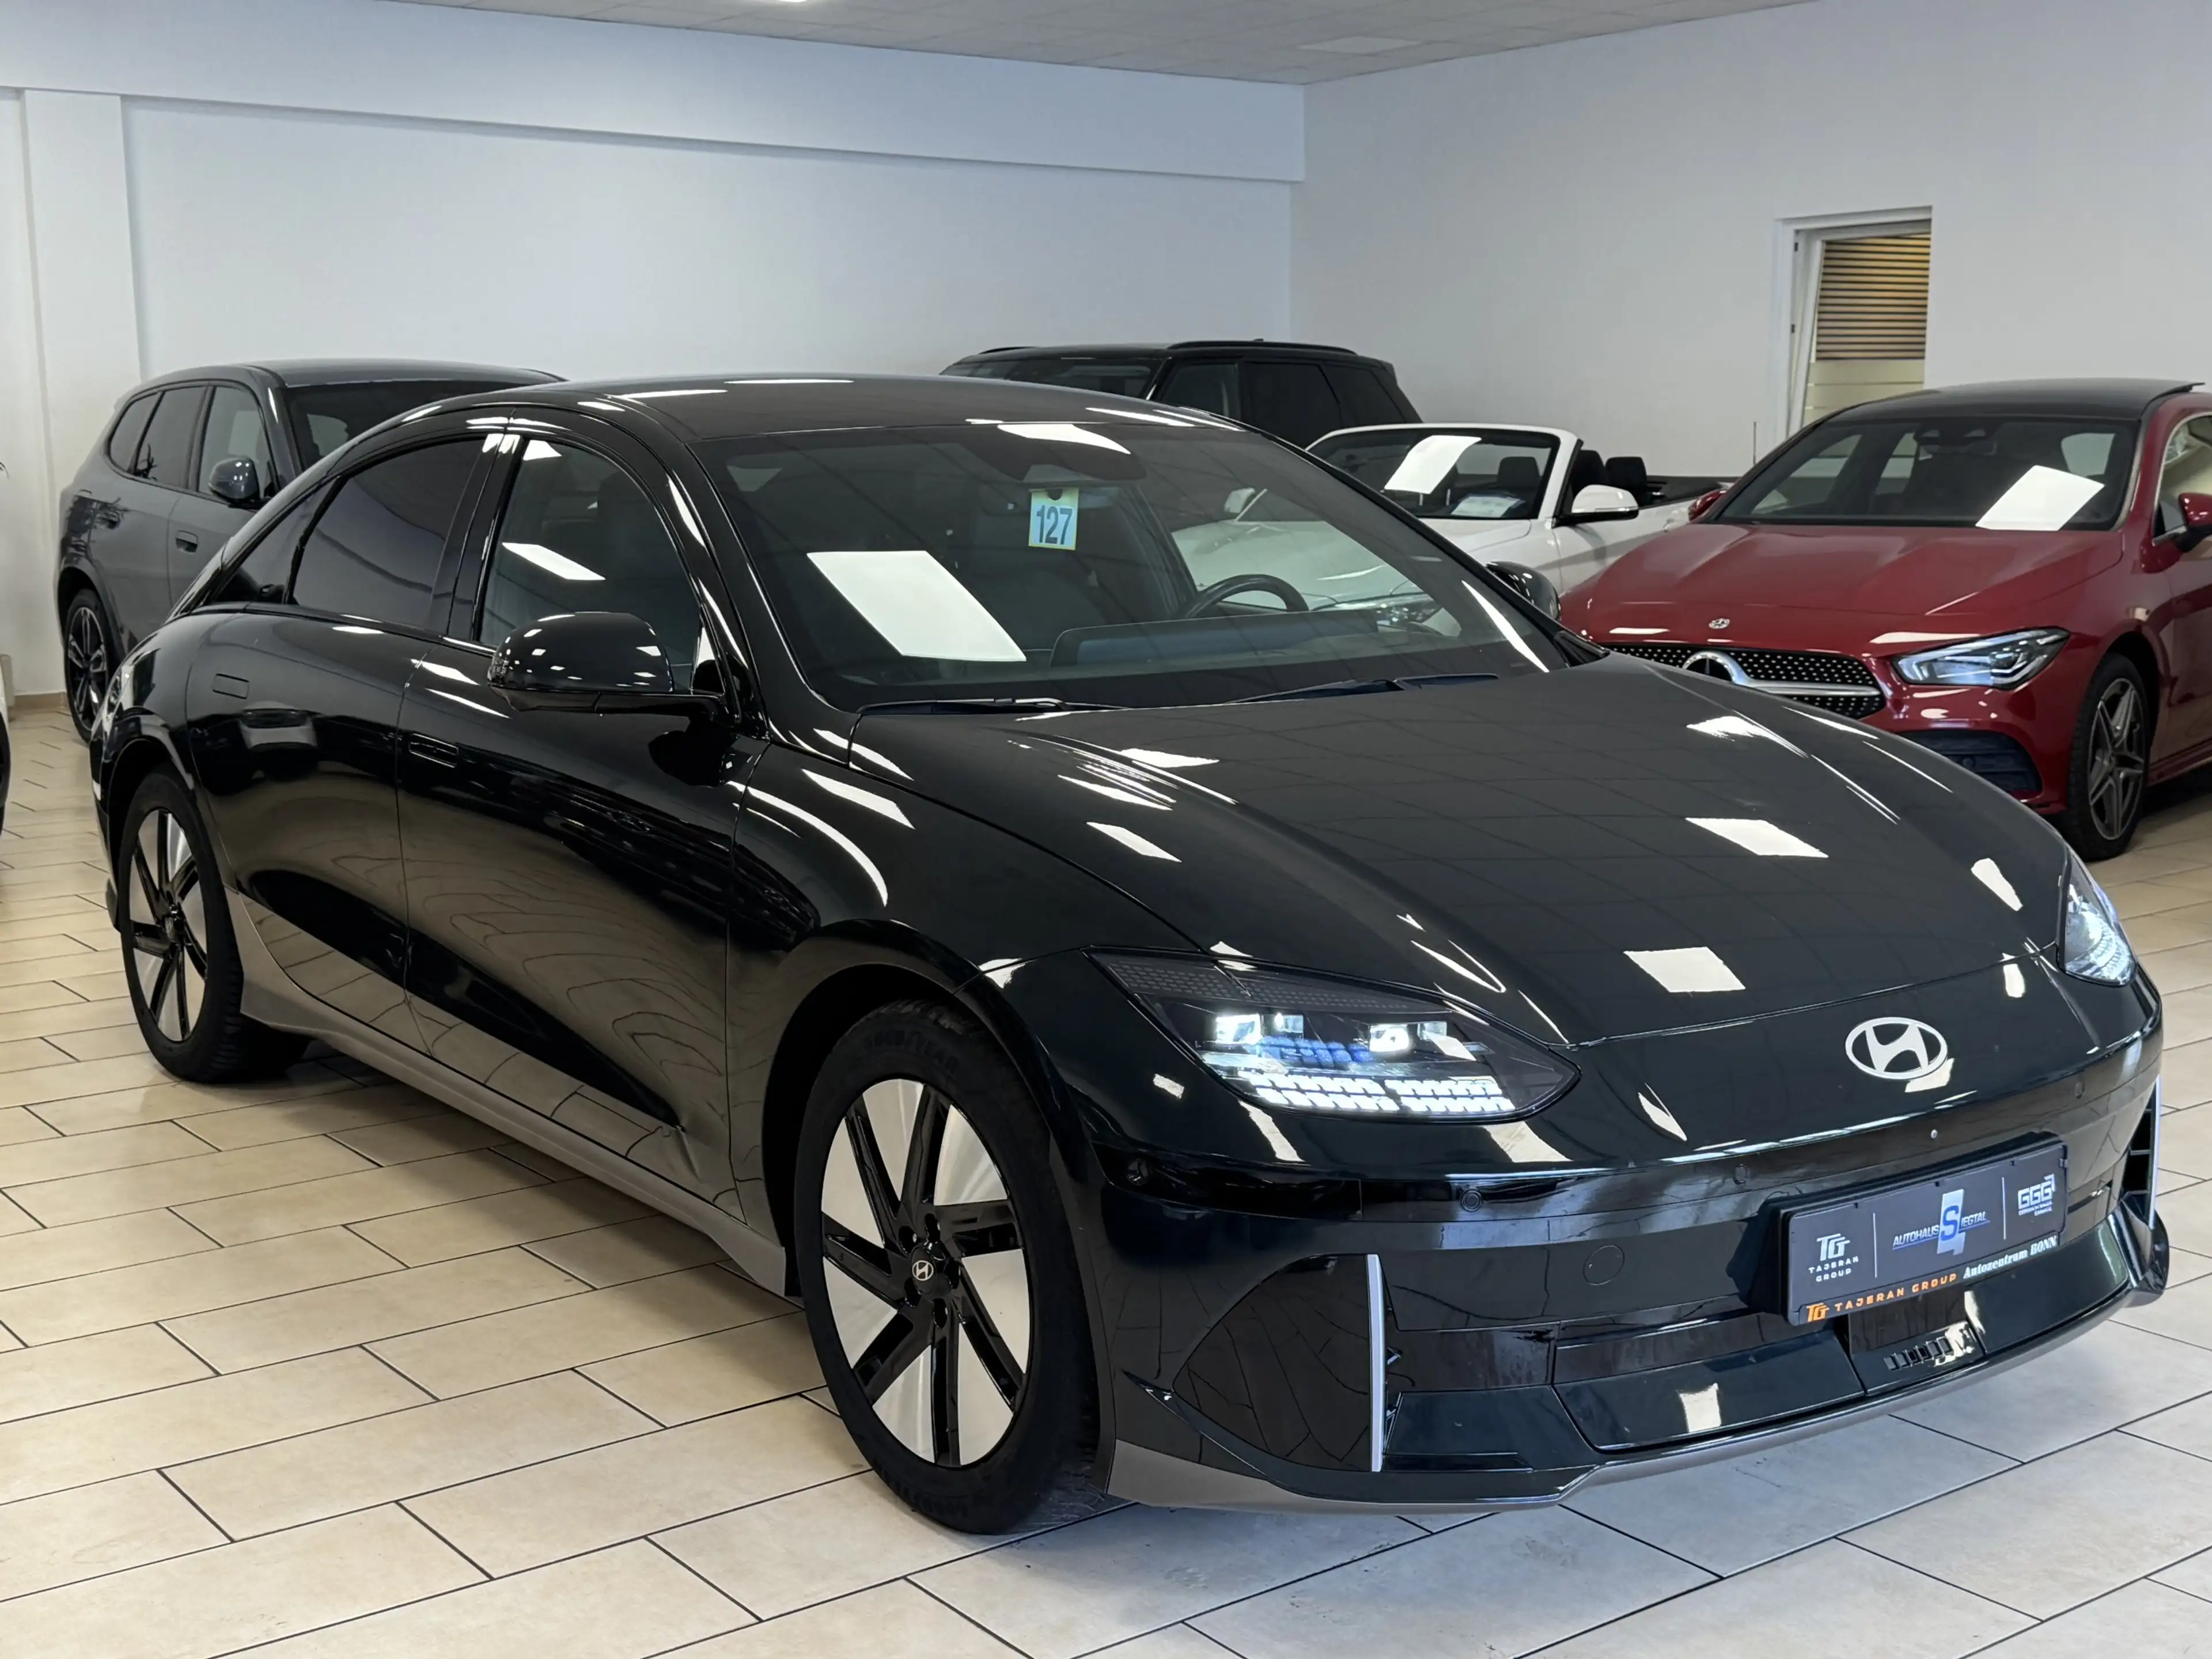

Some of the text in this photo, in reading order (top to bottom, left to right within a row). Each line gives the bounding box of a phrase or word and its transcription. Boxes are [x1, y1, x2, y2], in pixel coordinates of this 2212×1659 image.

[1036, 504, 1073, 545] 127
[2018, 1180, 2052, 1210] GGG
[1893, 1224, 1940, 1246] AUTOHAUS
[1808, 1256, 1859, 1274] TAJERAN
[1816, 1268, 1851, 1282] GROUP
[1834, 1287, 1904, 1312] TAJERAN
[1912, 1272, 1957, 1293] GROUP
[1963, 1249, 2028, 1279] Autozentrum
[2030, 1234, 2057, 1256] BONN
